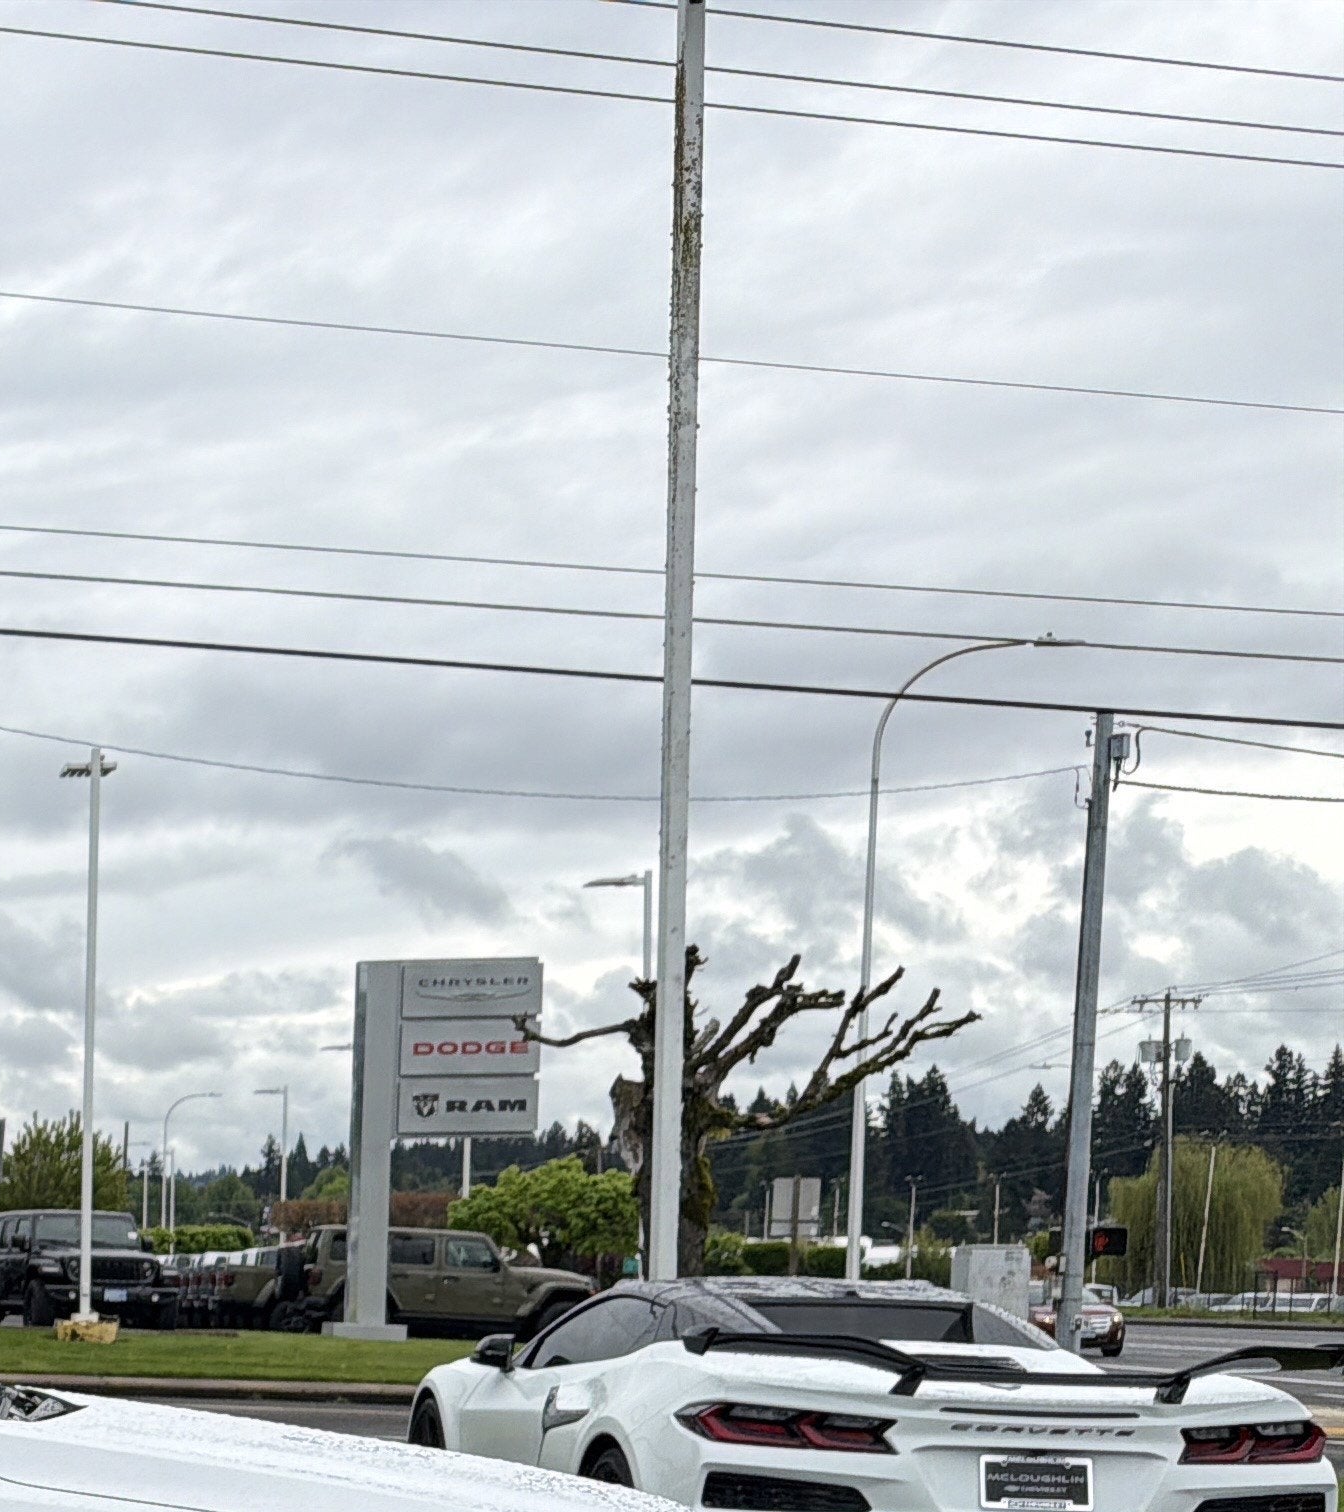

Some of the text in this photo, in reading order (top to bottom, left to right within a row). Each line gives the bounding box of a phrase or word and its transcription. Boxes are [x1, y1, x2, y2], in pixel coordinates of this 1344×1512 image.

[418, 976, 529, 987] CHRYSLER
[413, 1041, 528, 1056] DODGE
[446, 1098, 527, 1112] RAM
